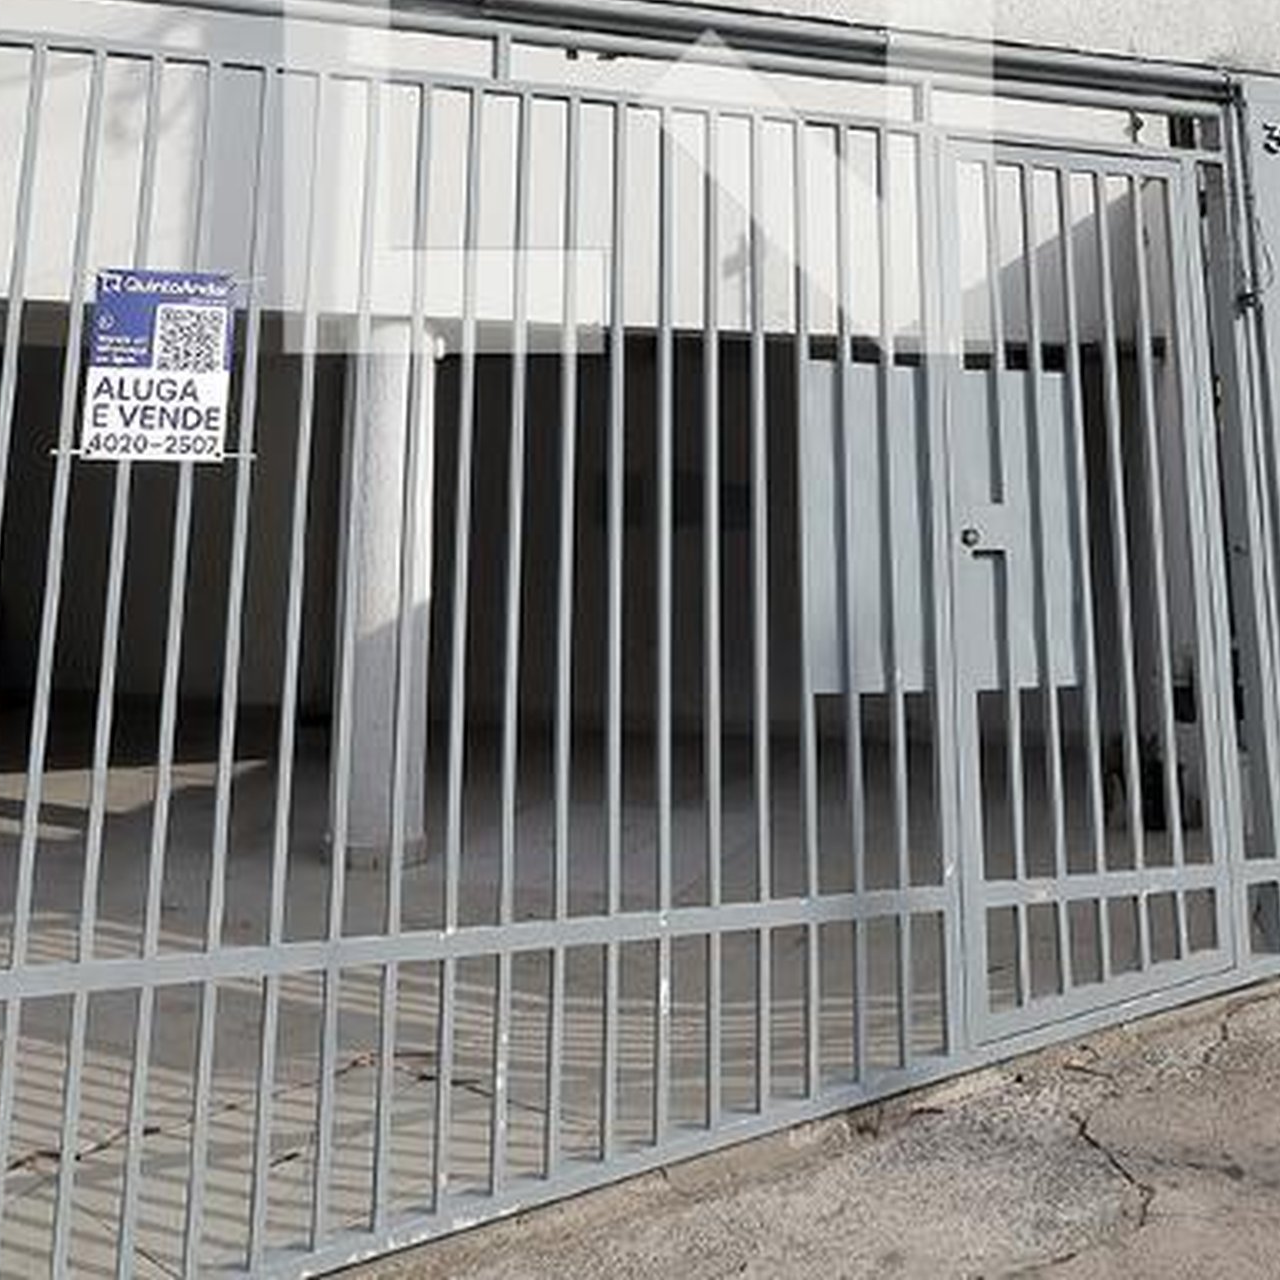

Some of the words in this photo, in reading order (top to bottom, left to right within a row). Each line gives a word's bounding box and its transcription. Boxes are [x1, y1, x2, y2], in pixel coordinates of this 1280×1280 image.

[93, 376, 199, 402] ALUGA
[92, 403, 109, 428] E
[118, 405, 220, 431] VENDE
[89, 433, 218, 455] 4020-2507
